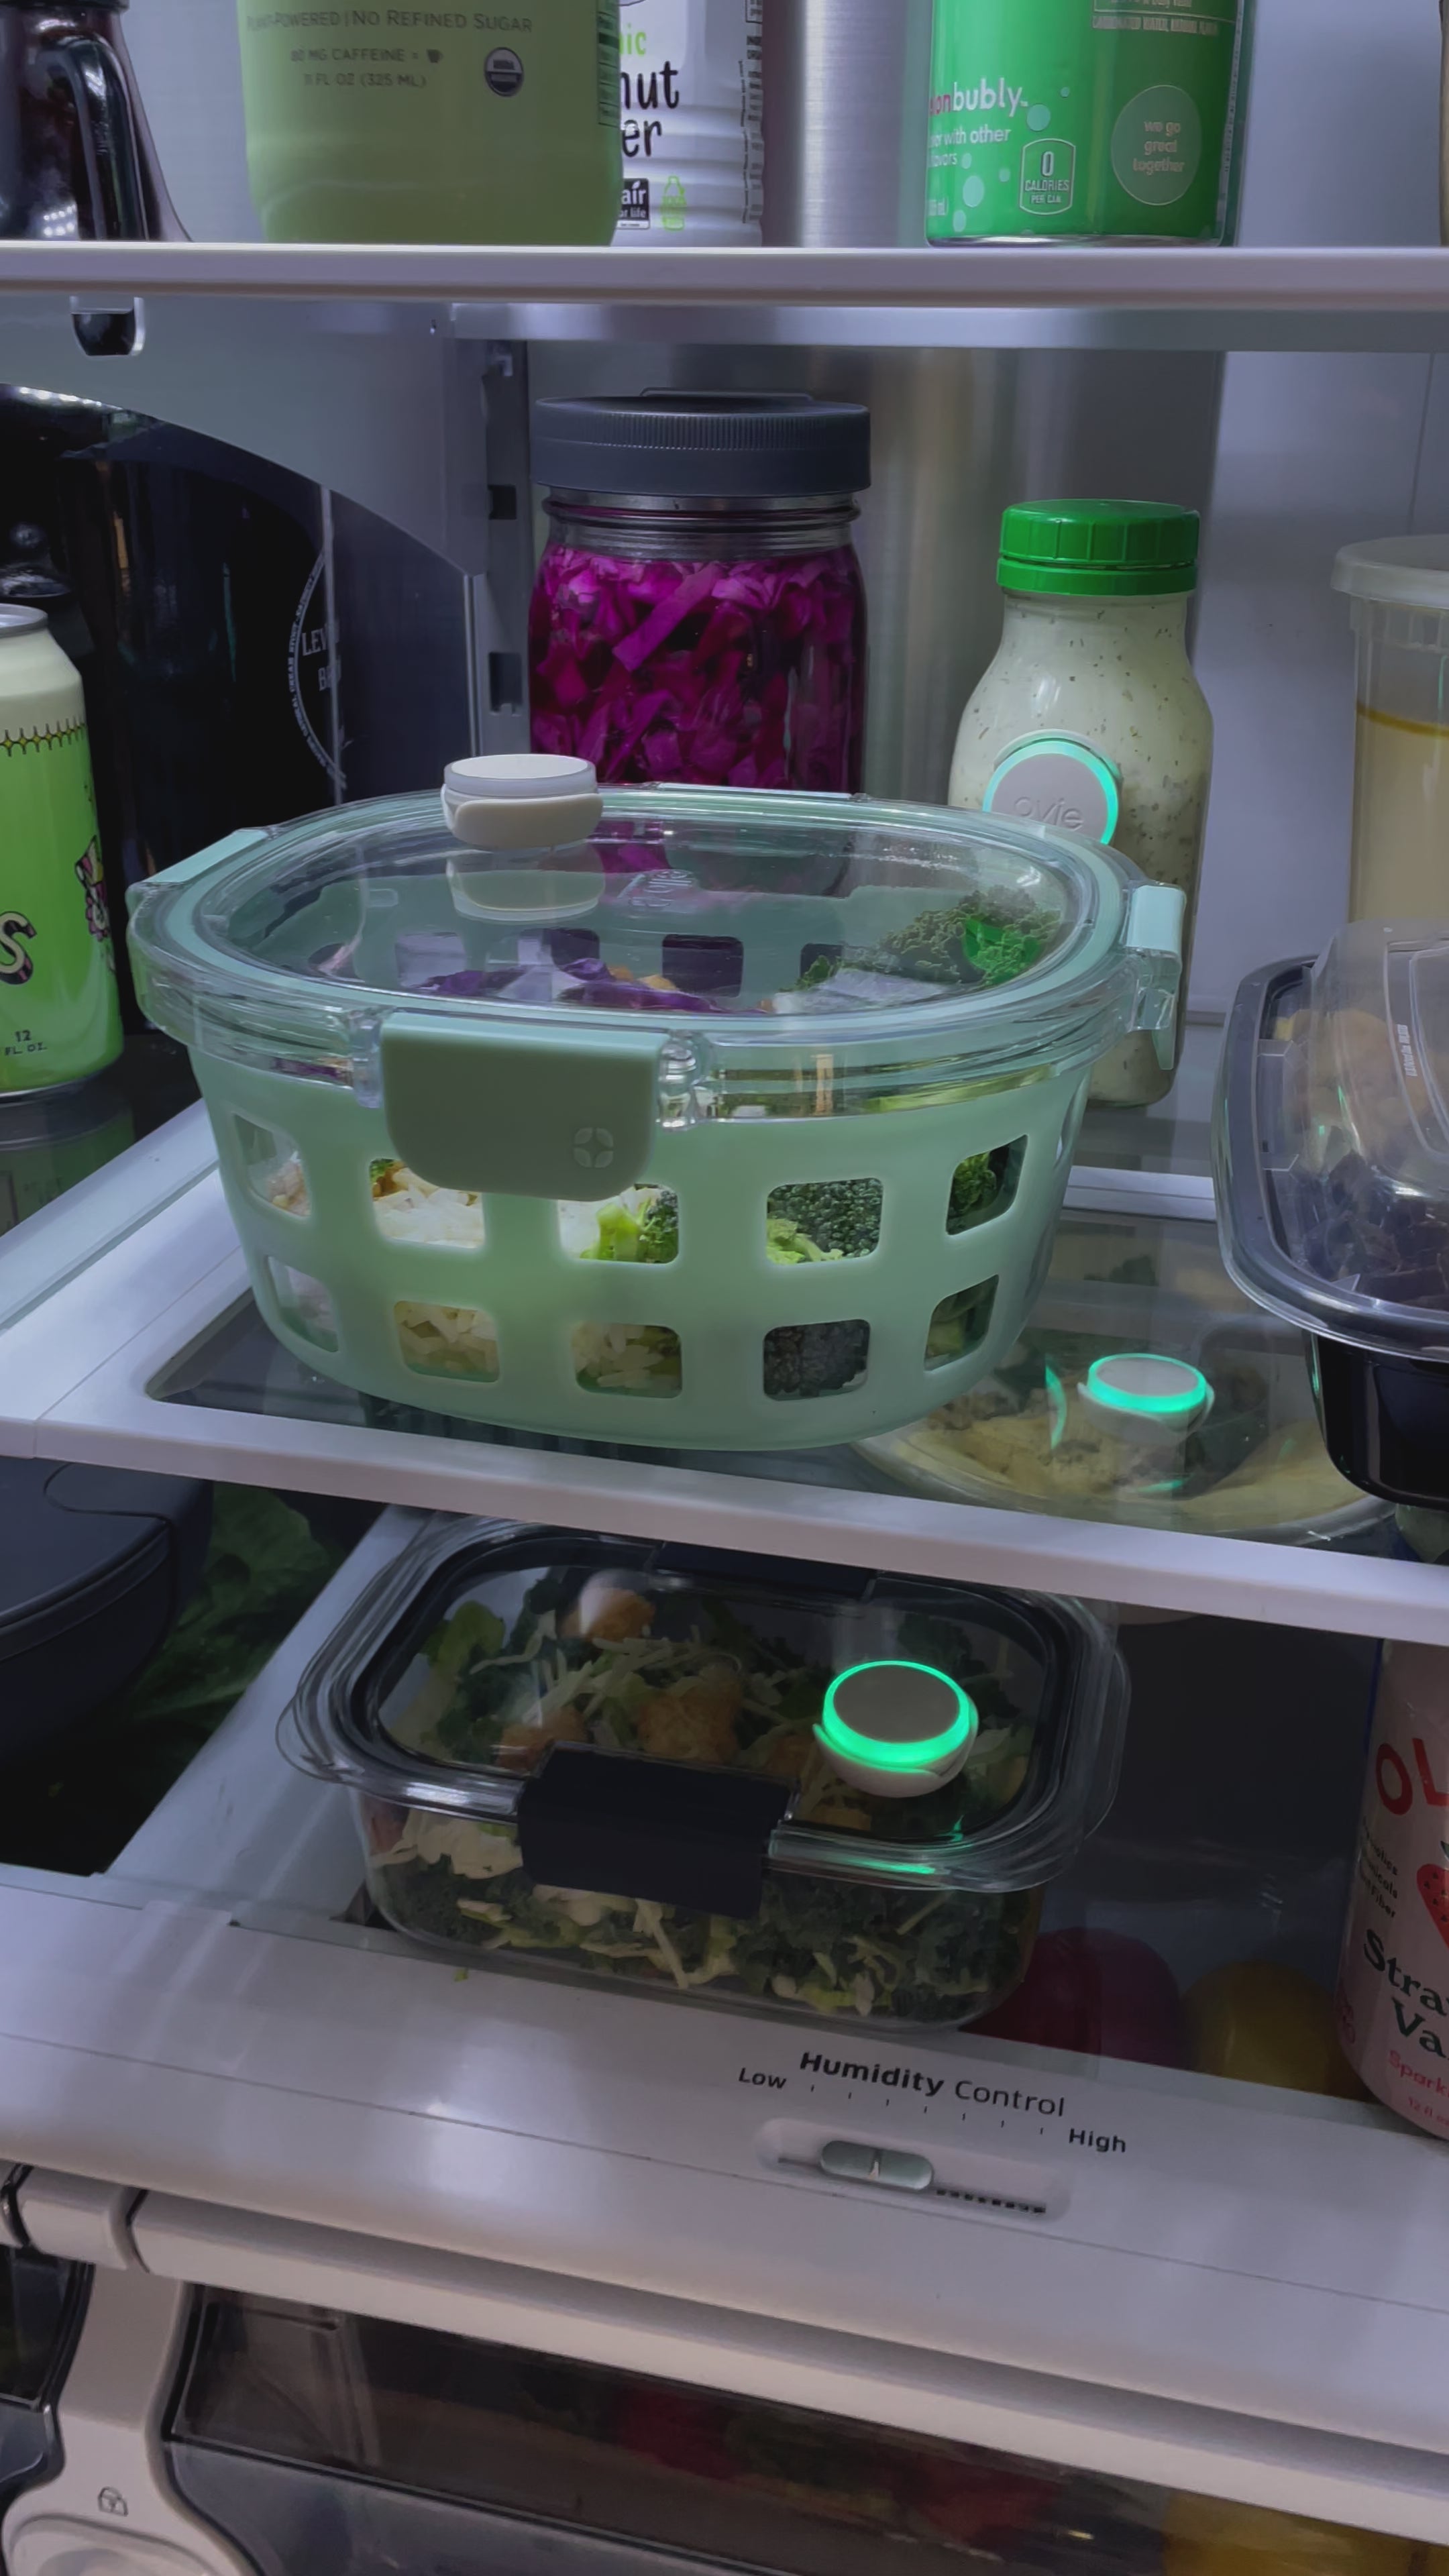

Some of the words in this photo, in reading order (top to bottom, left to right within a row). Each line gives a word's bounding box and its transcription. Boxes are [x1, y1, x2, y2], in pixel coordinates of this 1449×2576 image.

[352, 10, 380, 25] NO
[387, 9, 467, 28] REFINED
[474, 13, 533, 33] SUGAR
[331, 48, 405, 62] CAFFEINE
[944, 126, 967, 146] with
[969, 123, 1012, 144] other
[1042, 151, 1054, 176] 0
[1024, 179, 1070, 192] CALORIES
[1014, 796, 1084, 831] ovie
[15, 1030, 32, 1042] 12
[1363, 1928, 1449, 2017] Stra
[1391, 1996, 1449, 2060] Va
[739, 2067, 787, 2089] Low
[800, 2051, 945, 2097] Humidity
[955, 2080, 1065, 2116] Control
[1069, 2128, 1127, 2153] High
